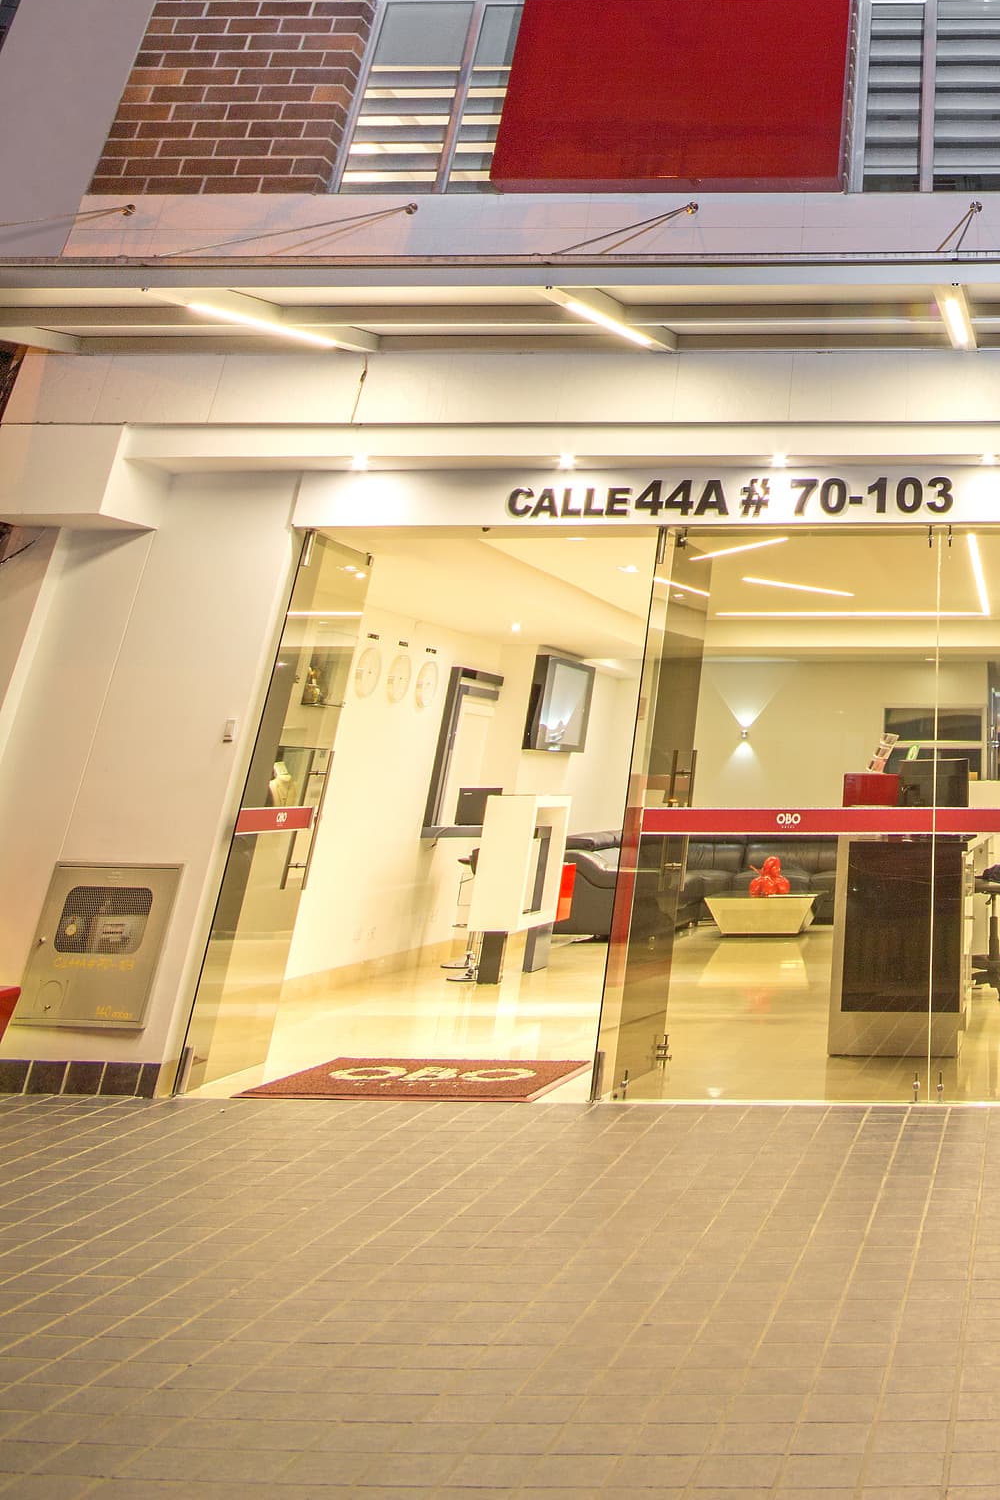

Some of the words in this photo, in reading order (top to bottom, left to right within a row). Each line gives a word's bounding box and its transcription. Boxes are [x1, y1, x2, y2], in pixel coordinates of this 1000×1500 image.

[506, 487, 632, 518] CALLE
[634, 479, 729, 516] 44A
[740, 478, 770, 517] #
[791, 476, 954, 516] 70-103
[776, 813, 801, 825] OBO
[328, 1066, 537, 1082] OBO
